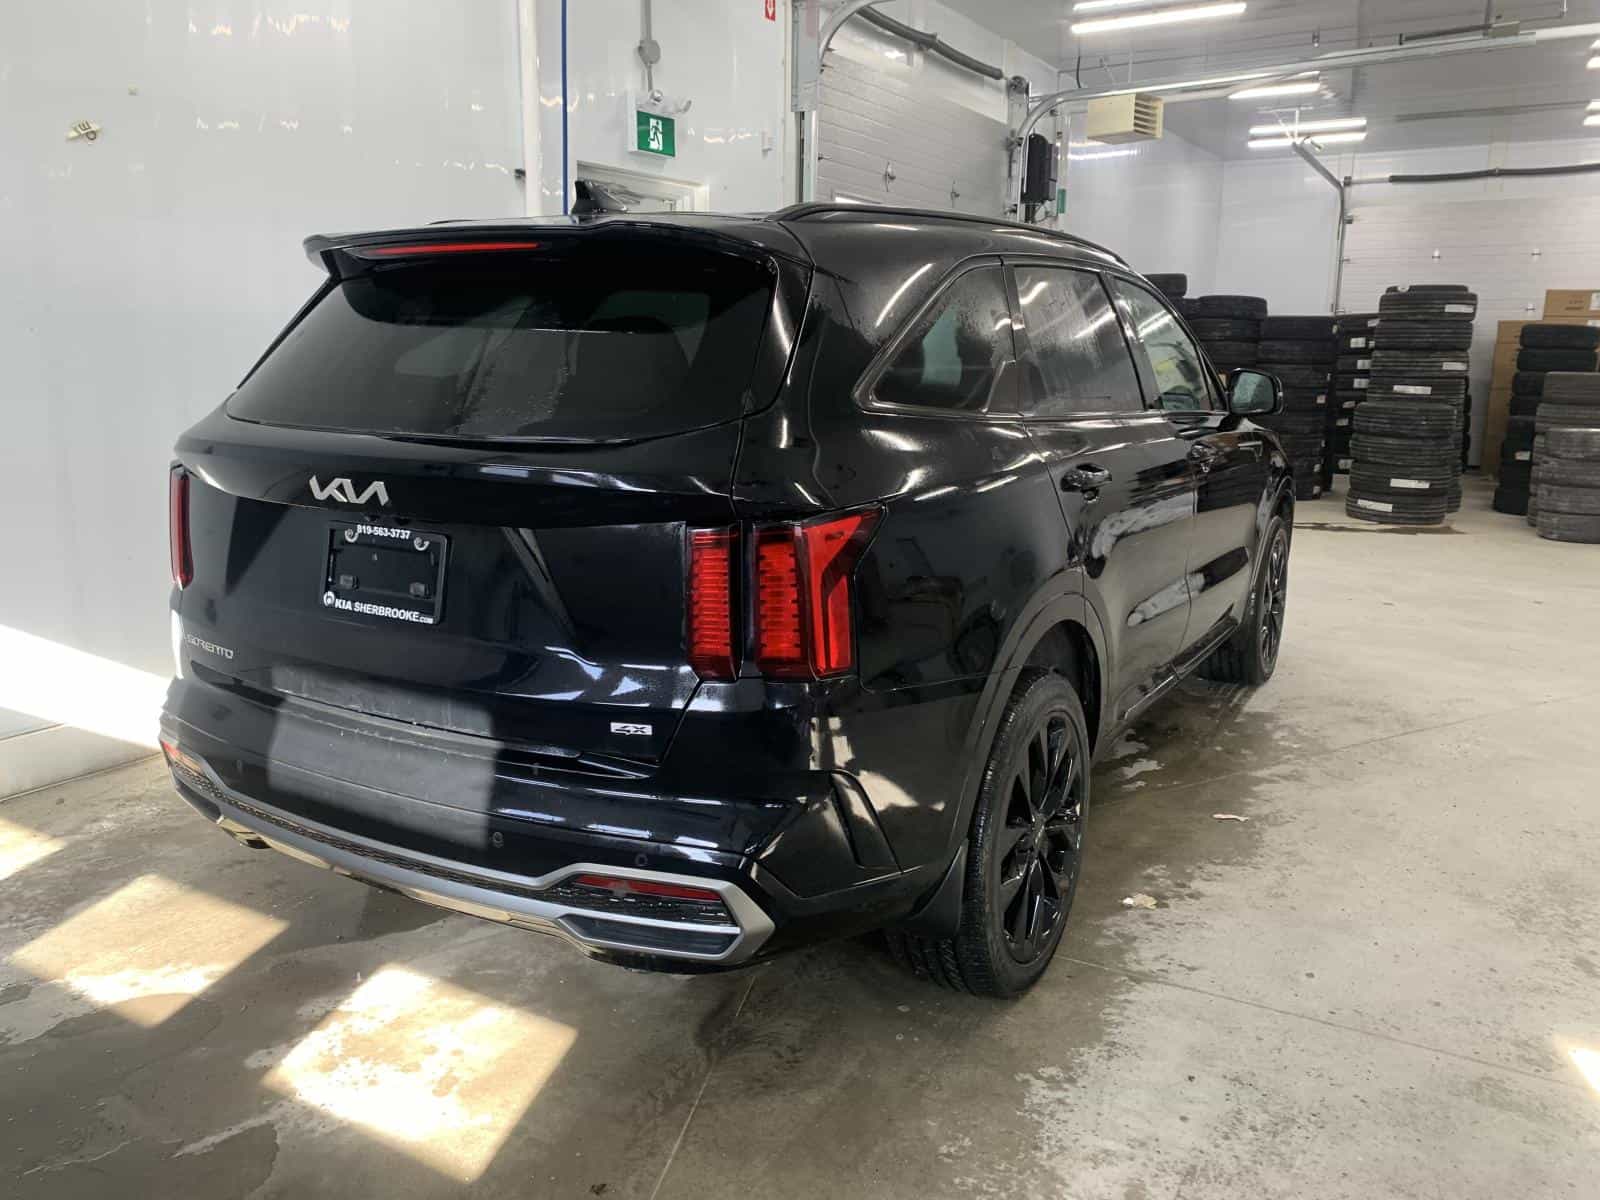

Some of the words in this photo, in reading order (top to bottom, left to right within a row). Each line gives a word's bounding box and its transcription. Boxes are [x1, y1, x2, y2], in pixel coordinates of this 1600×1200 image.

[309, 475, 389, 506] KIA
[356, 524, 410, 540] 819-563-3737
[334, 598, 353, 611] KIA
